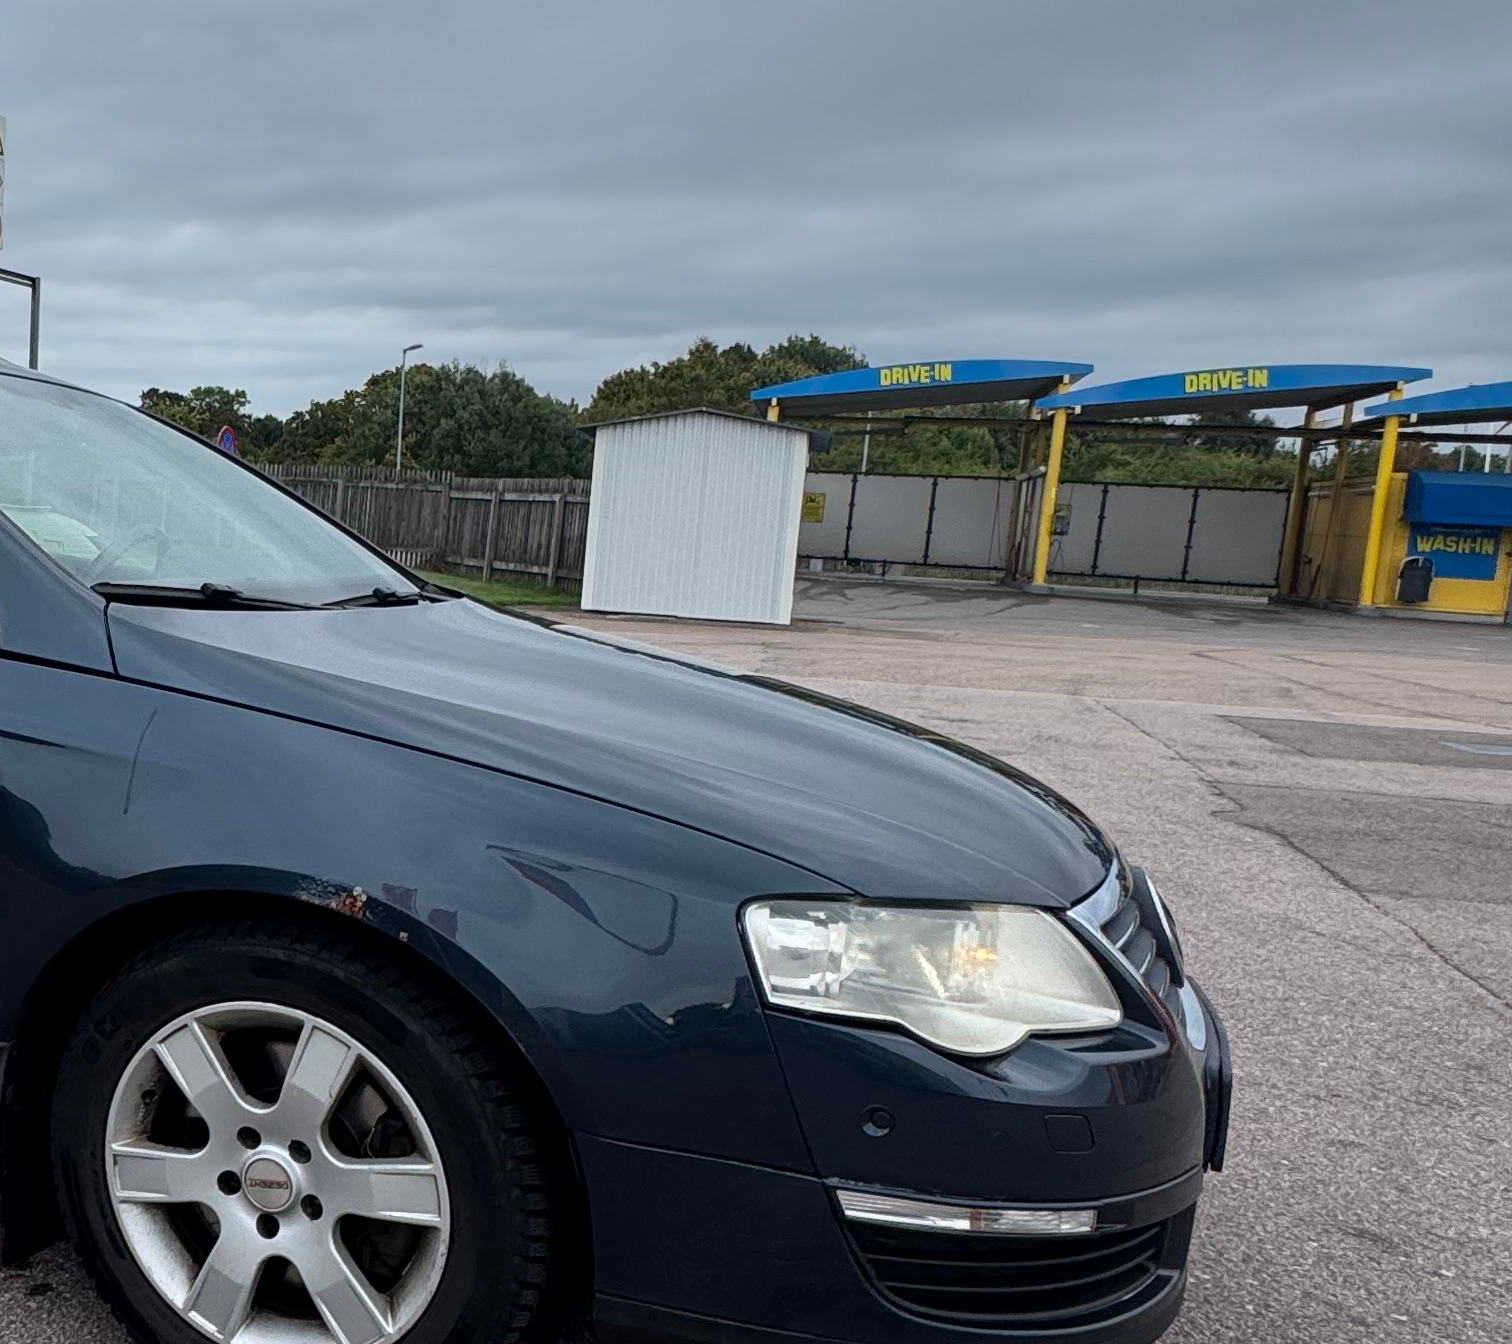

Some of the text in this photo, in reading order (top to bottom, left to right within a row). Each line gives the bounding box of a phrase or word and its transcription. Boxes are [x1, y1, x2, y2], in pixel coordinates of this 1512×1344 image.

[880, 363, 952, 386] DRIVE-IN
[1185, 369, 1268, 393] DRIVE-IN
[1416, 535, 1495, 555] WASH-IN
